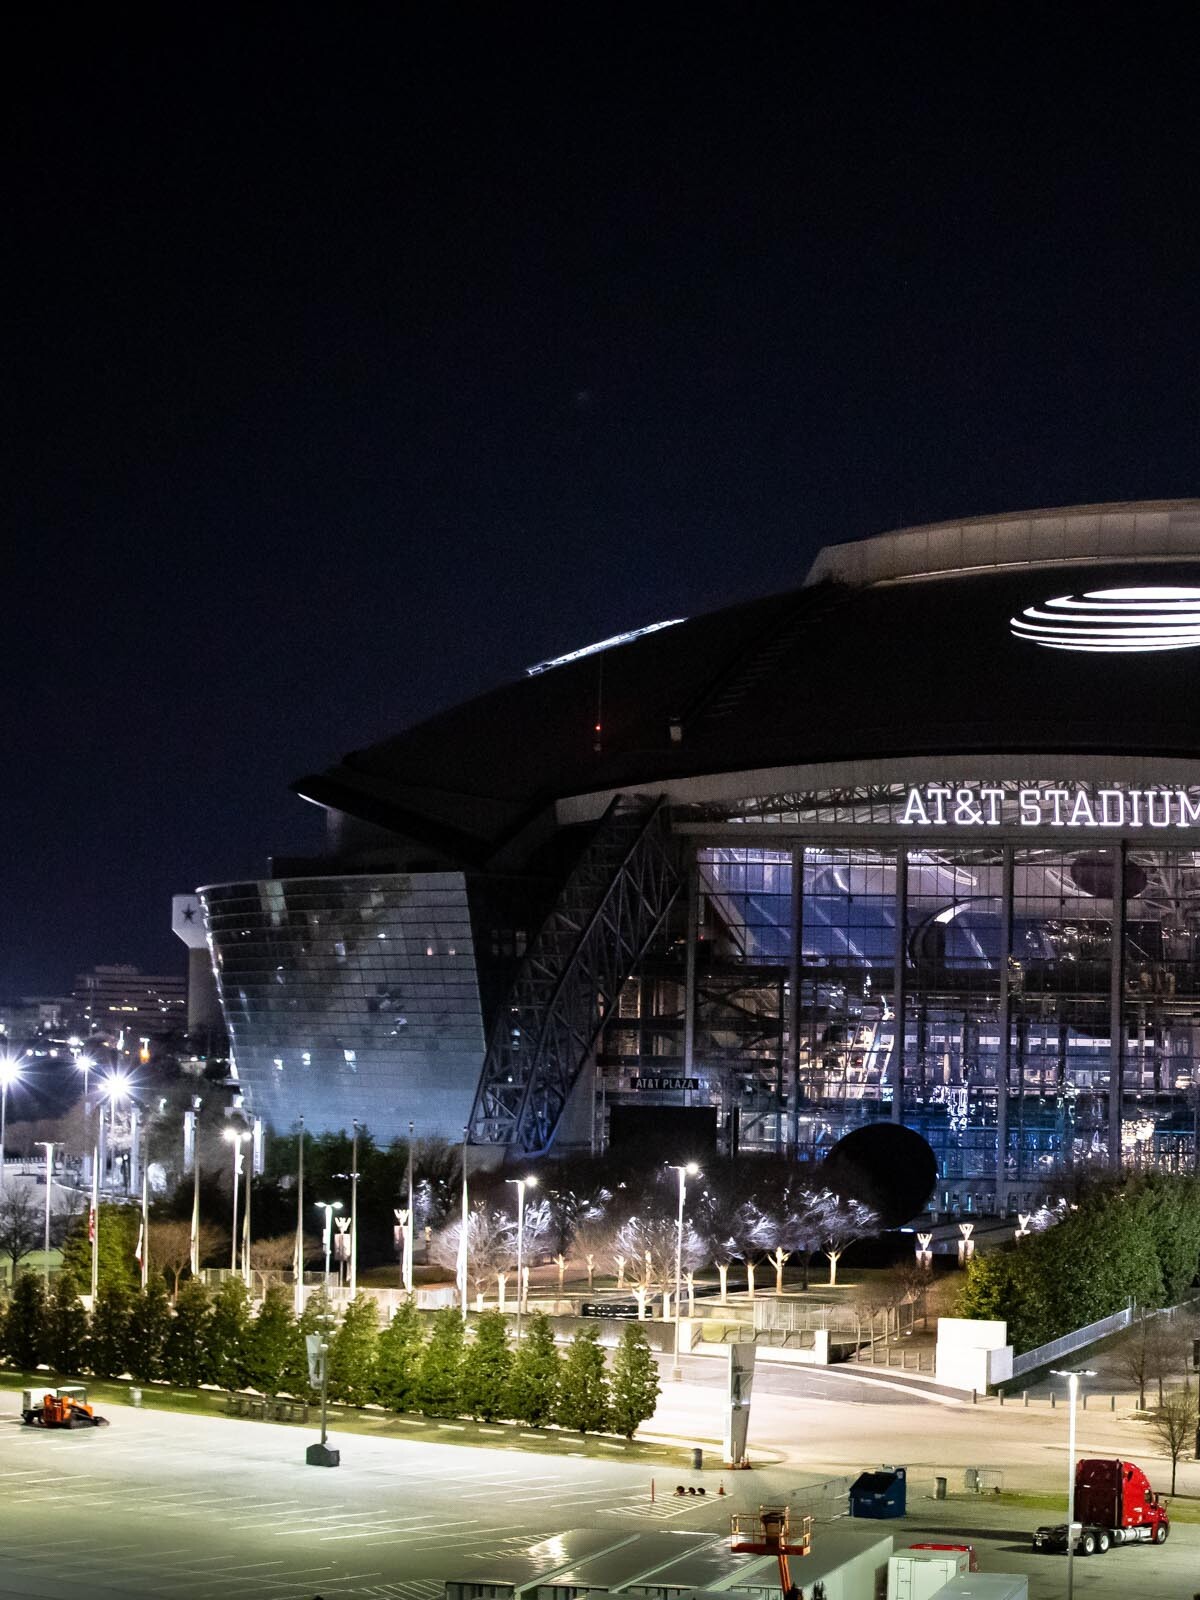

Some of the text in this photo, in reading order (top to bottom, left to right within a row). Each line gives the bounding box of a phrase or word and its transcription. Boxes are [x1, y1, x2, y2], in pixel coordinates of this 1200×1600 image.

[900, 788, 1005, 825] AT&T
[636, 1078, 694, 1089] AT&T PLAZA
